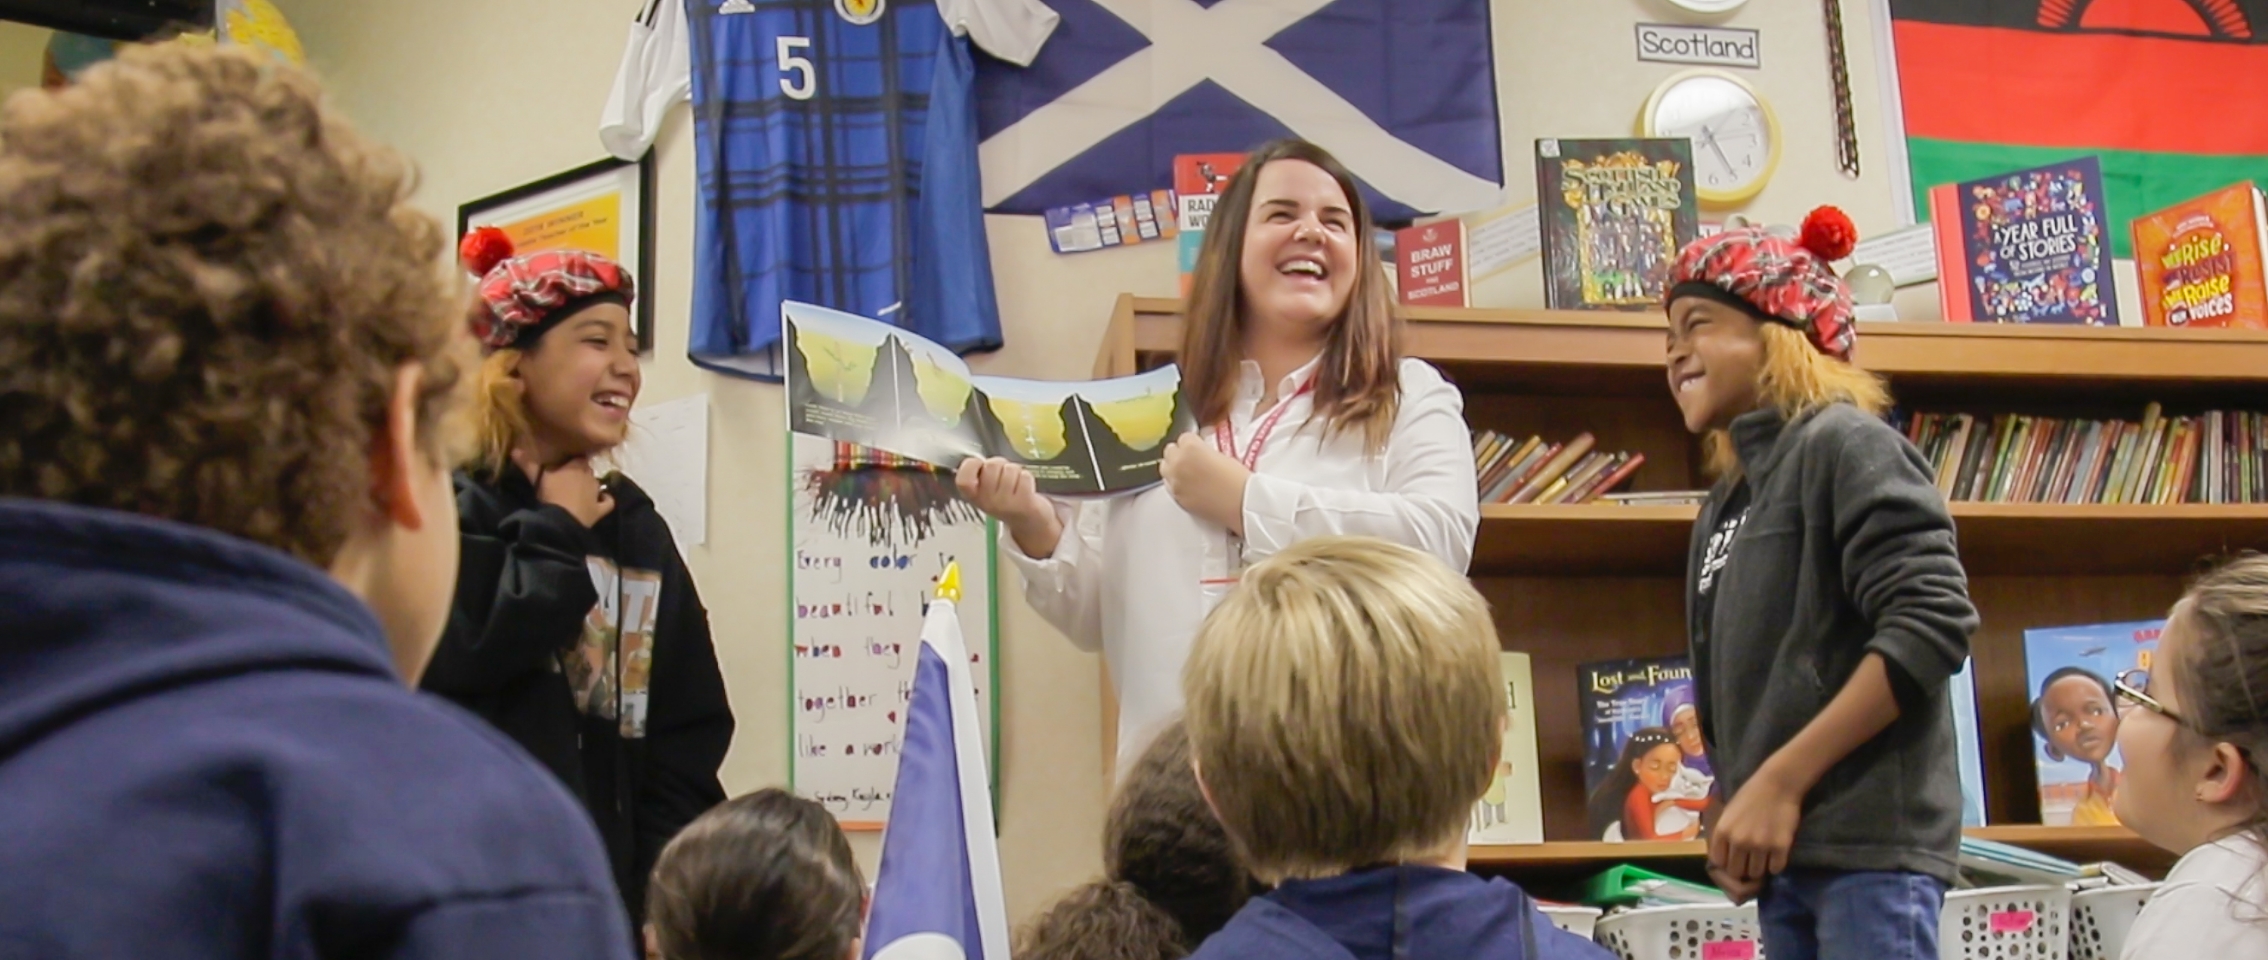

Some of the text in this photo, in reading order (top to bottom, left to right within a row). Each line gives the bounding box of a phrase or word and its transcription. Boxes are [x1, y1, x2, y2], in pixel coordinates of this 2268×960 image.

[1643, 30, 1754, 59] Scotland
[776, 36, 816, 100] 5
[1994, 214, 2078, 246] A YEAR FULL
[1411, 243, 1452, 263] BRAW
[2000, 233, 2076, 261] OF STORIES
[1410, 258, 1453, 278] STUFF
[1408, 282, 1459, 300] SCOTLAND
[870, 544, 917, 570] color
[1592, 670, 1623, 694] Lost
[1647, 665, 1693, 687] Foun
[798, 686, 878, 724] together
[798, 734, 826, 758] like
[845, 743, 854, 755] a
